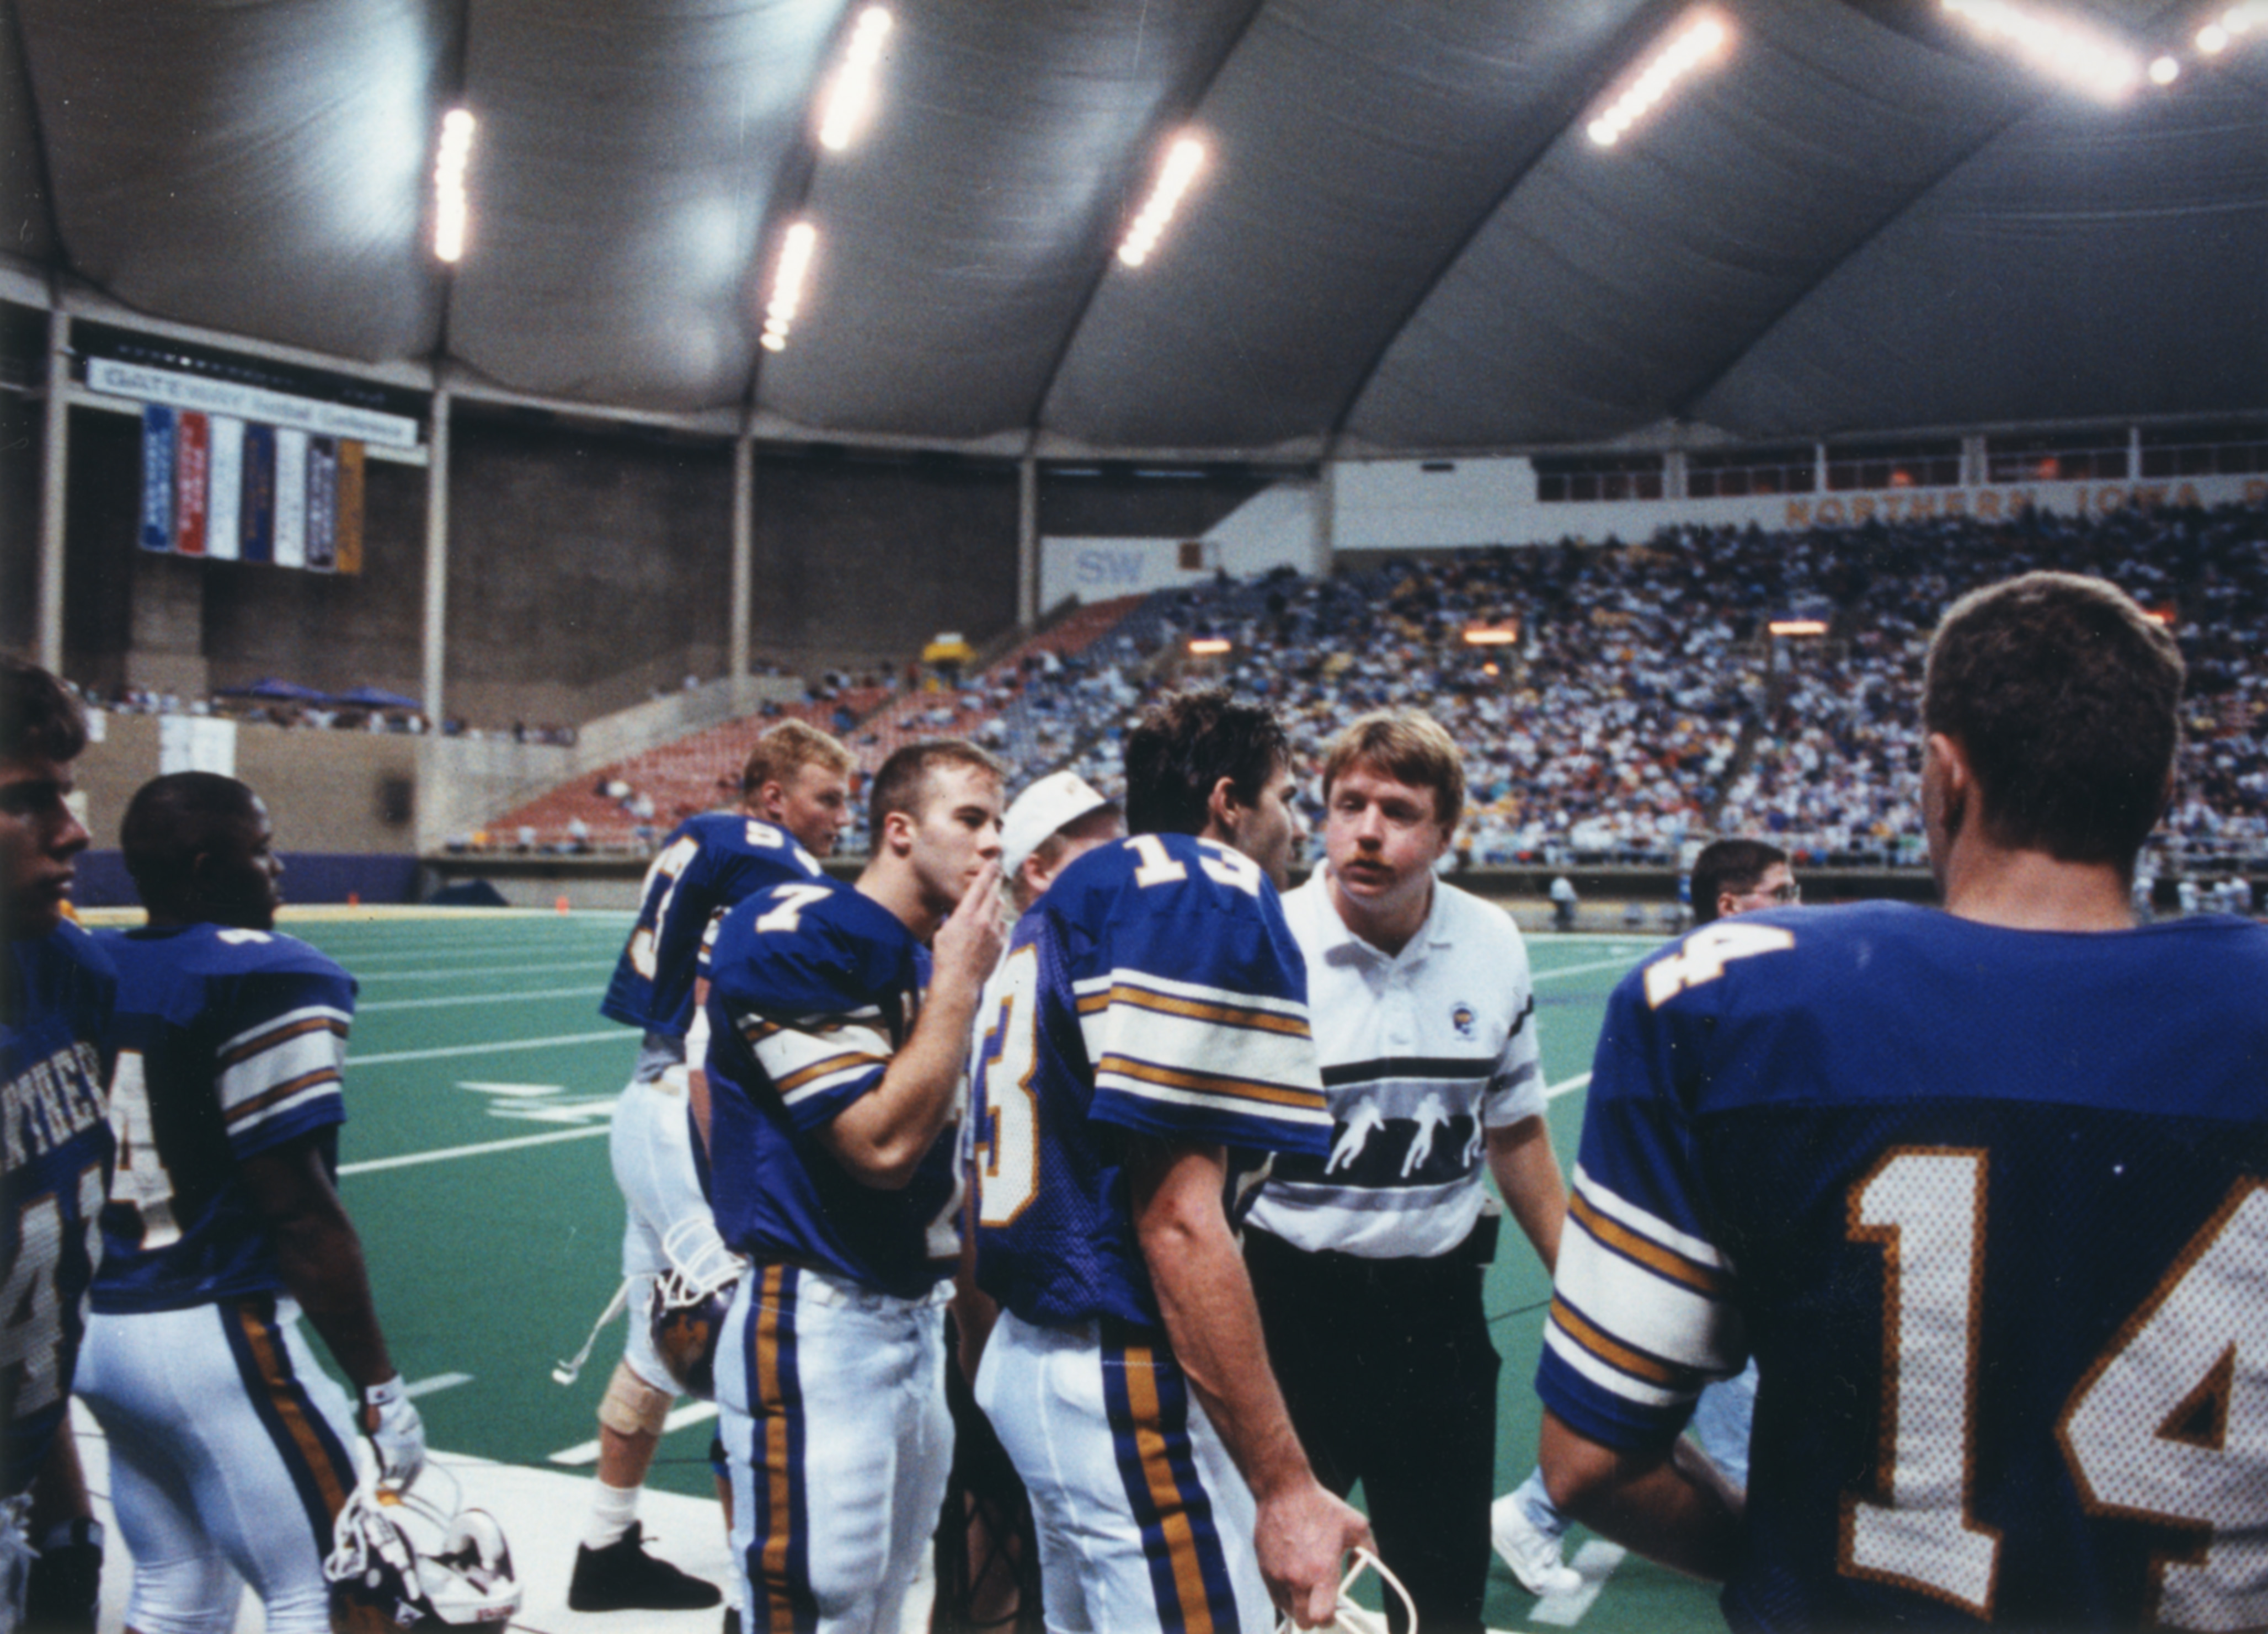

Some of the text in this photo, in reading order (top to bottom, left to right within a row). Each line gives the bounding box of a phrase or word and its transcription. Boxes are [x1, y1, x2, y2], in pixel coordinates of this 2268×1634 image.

[1076, 550, 1144, 583] SW
[1122, 833, 1262, 898] 13
[755, 882, 834, 934] 7
[1642, 923, 1795, 1010] 4
[1837, 1144, 2268, 1634] 14
